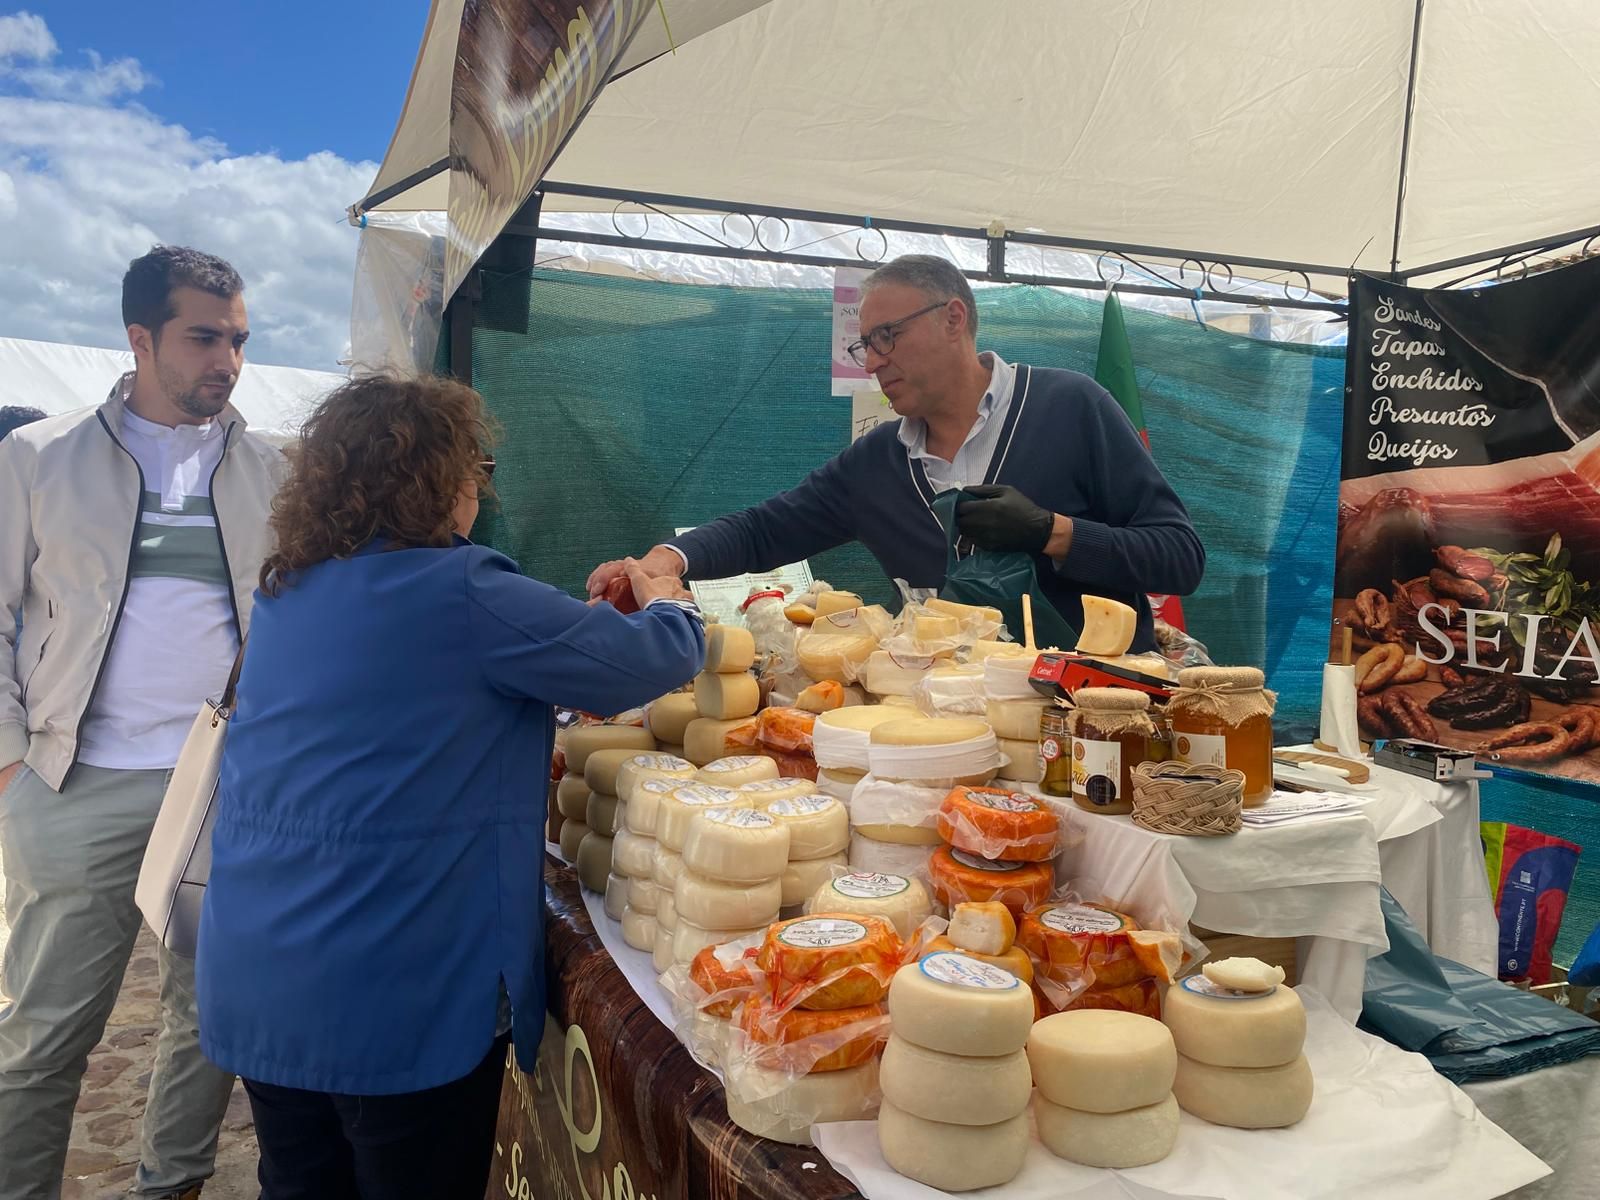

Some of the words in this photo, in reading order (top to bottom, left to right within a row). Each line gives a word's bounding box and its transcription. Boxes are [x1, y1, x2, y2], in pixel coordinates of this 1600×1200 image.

[1374, 295, 1442, 333] Sandes
[1371, 327, 1446, 360] Tapas
[1371, 361, 1484, 393] Enchidos
[1368, 395, 1496, 428] Presuntos
[1367, 430, 1459, 467] Queijos
[1415, 602, 1600, 685] SEIA
